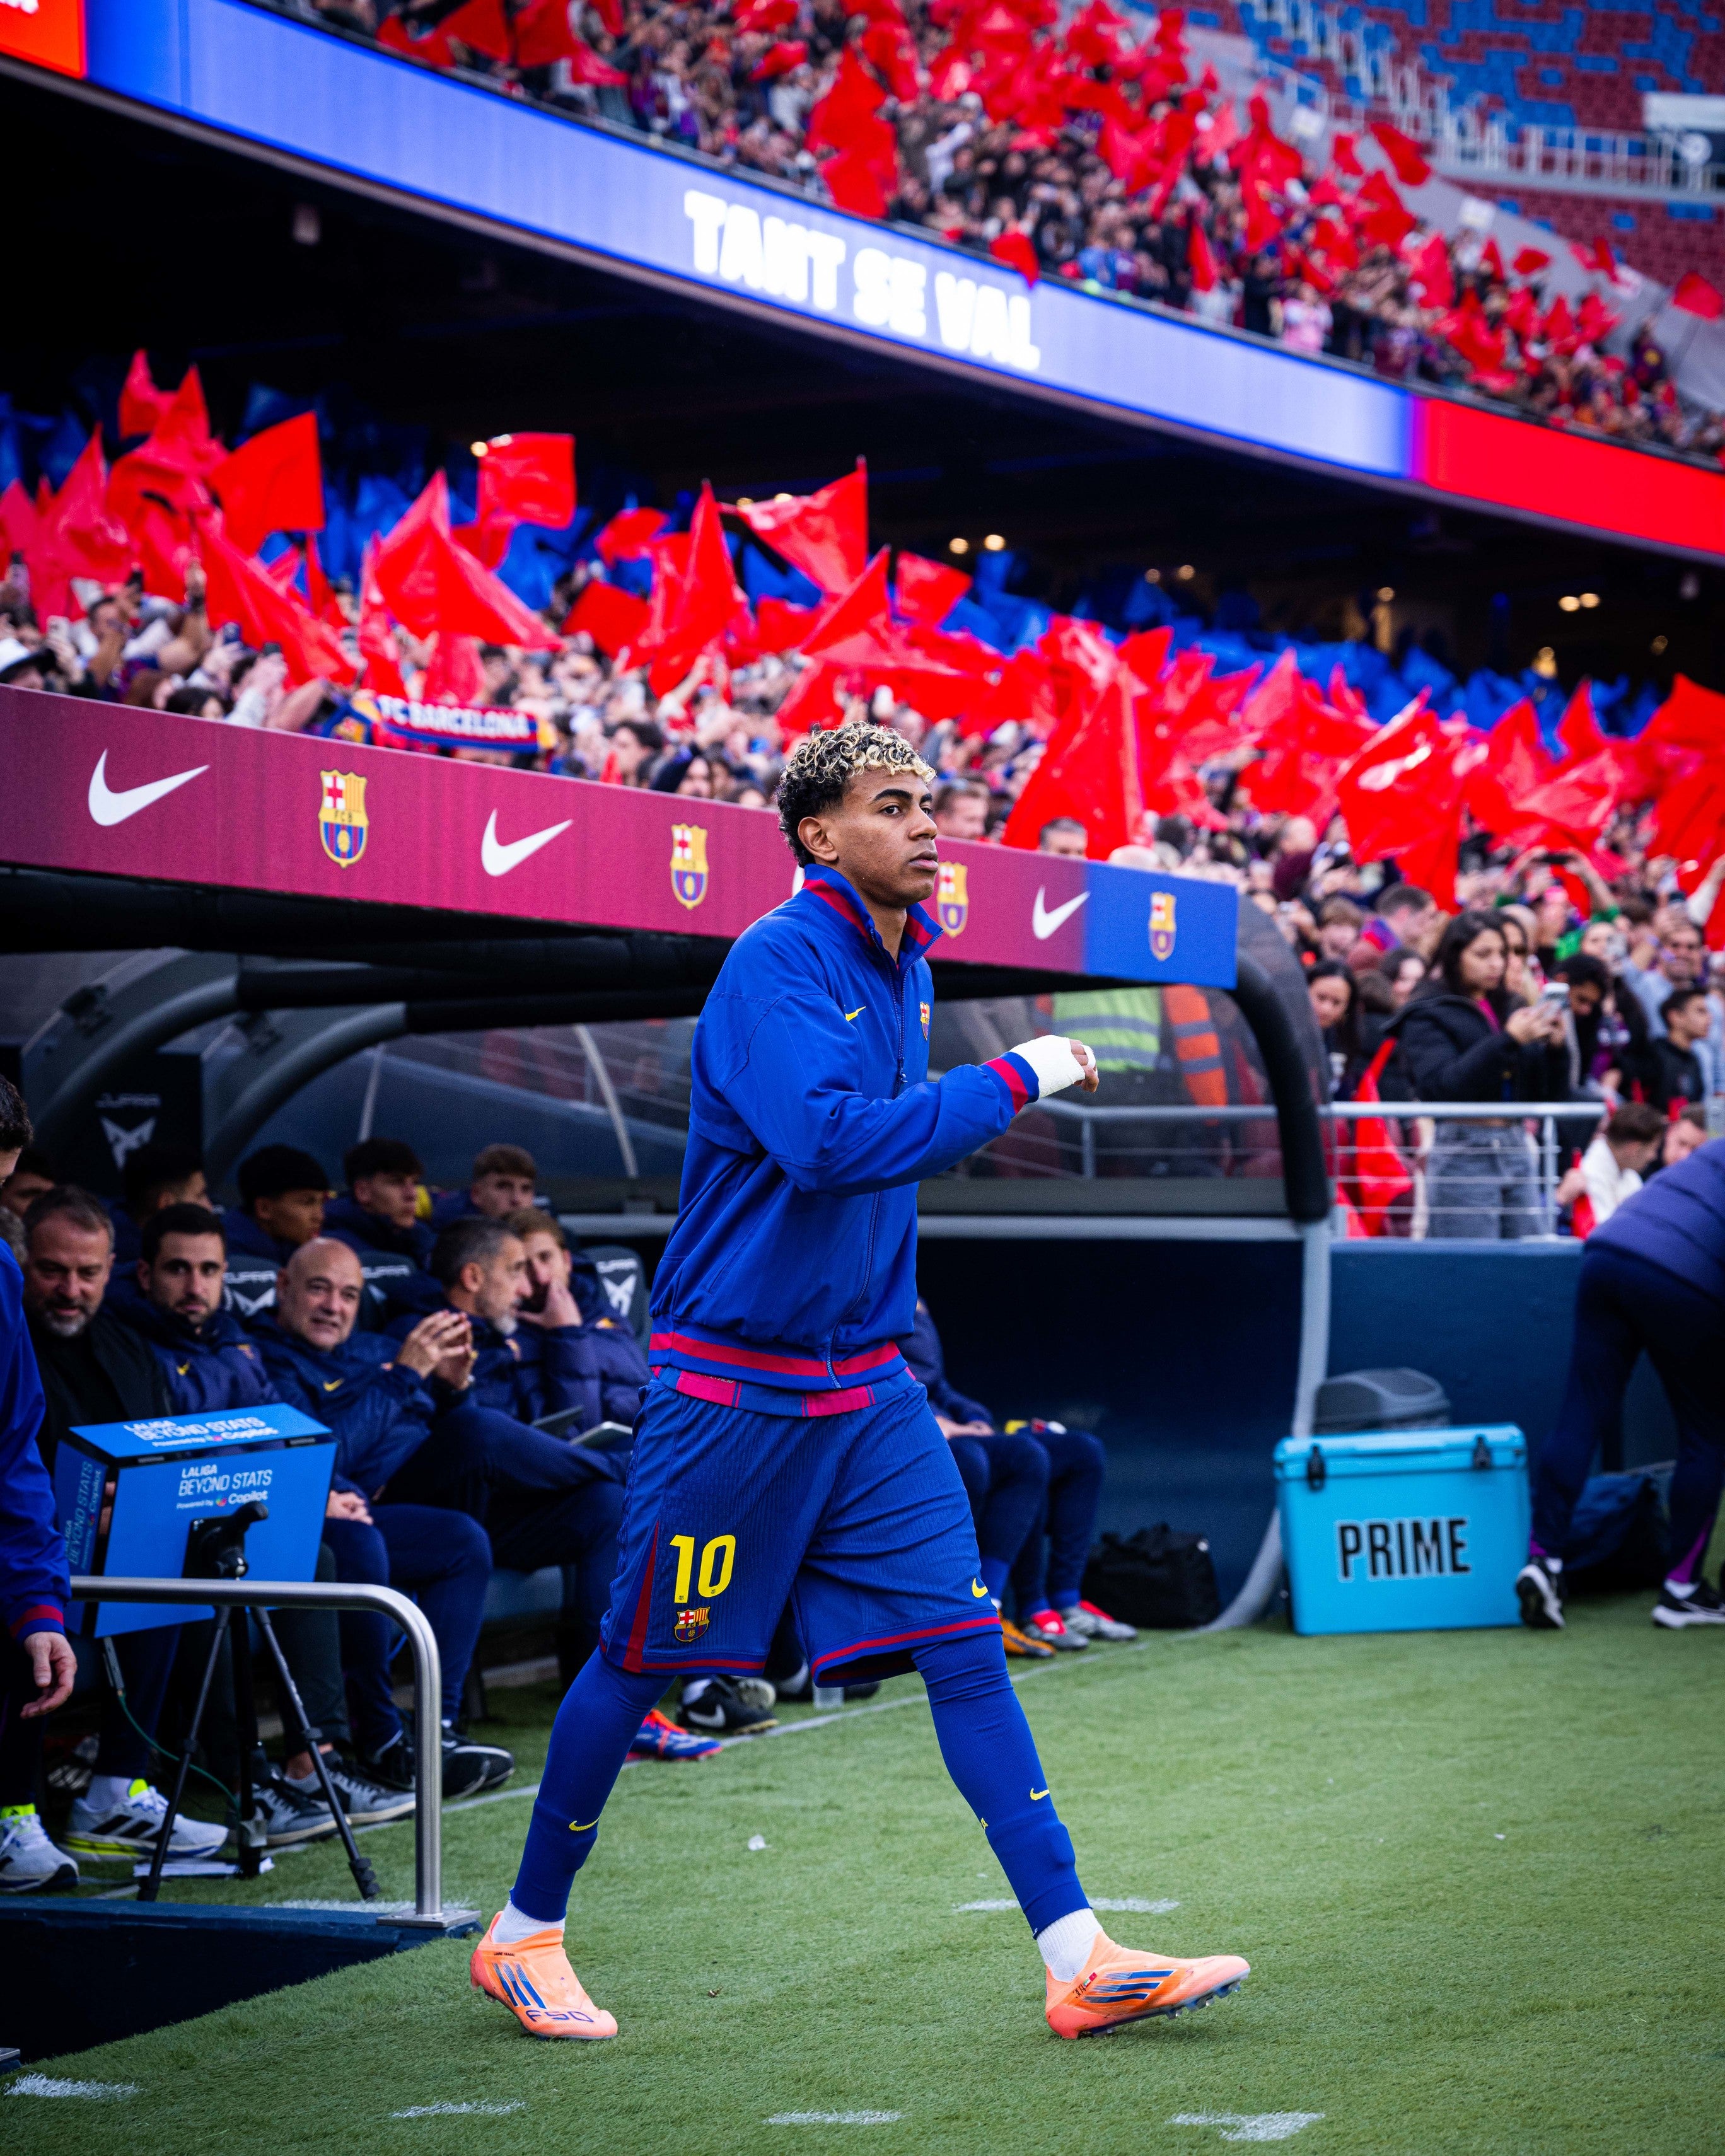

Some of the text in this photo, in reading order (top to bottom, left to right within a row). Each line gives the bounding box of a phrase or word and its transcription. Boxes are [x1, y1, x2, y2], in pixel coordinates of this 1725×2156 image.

[178, 1469, 273, 1497] BEYOND STATS
[182, 1464, 218, 1478] LALIGA
[669, 1534, 736, 1603] 10
[1337, 1516, 1472, 1580] PRIME
